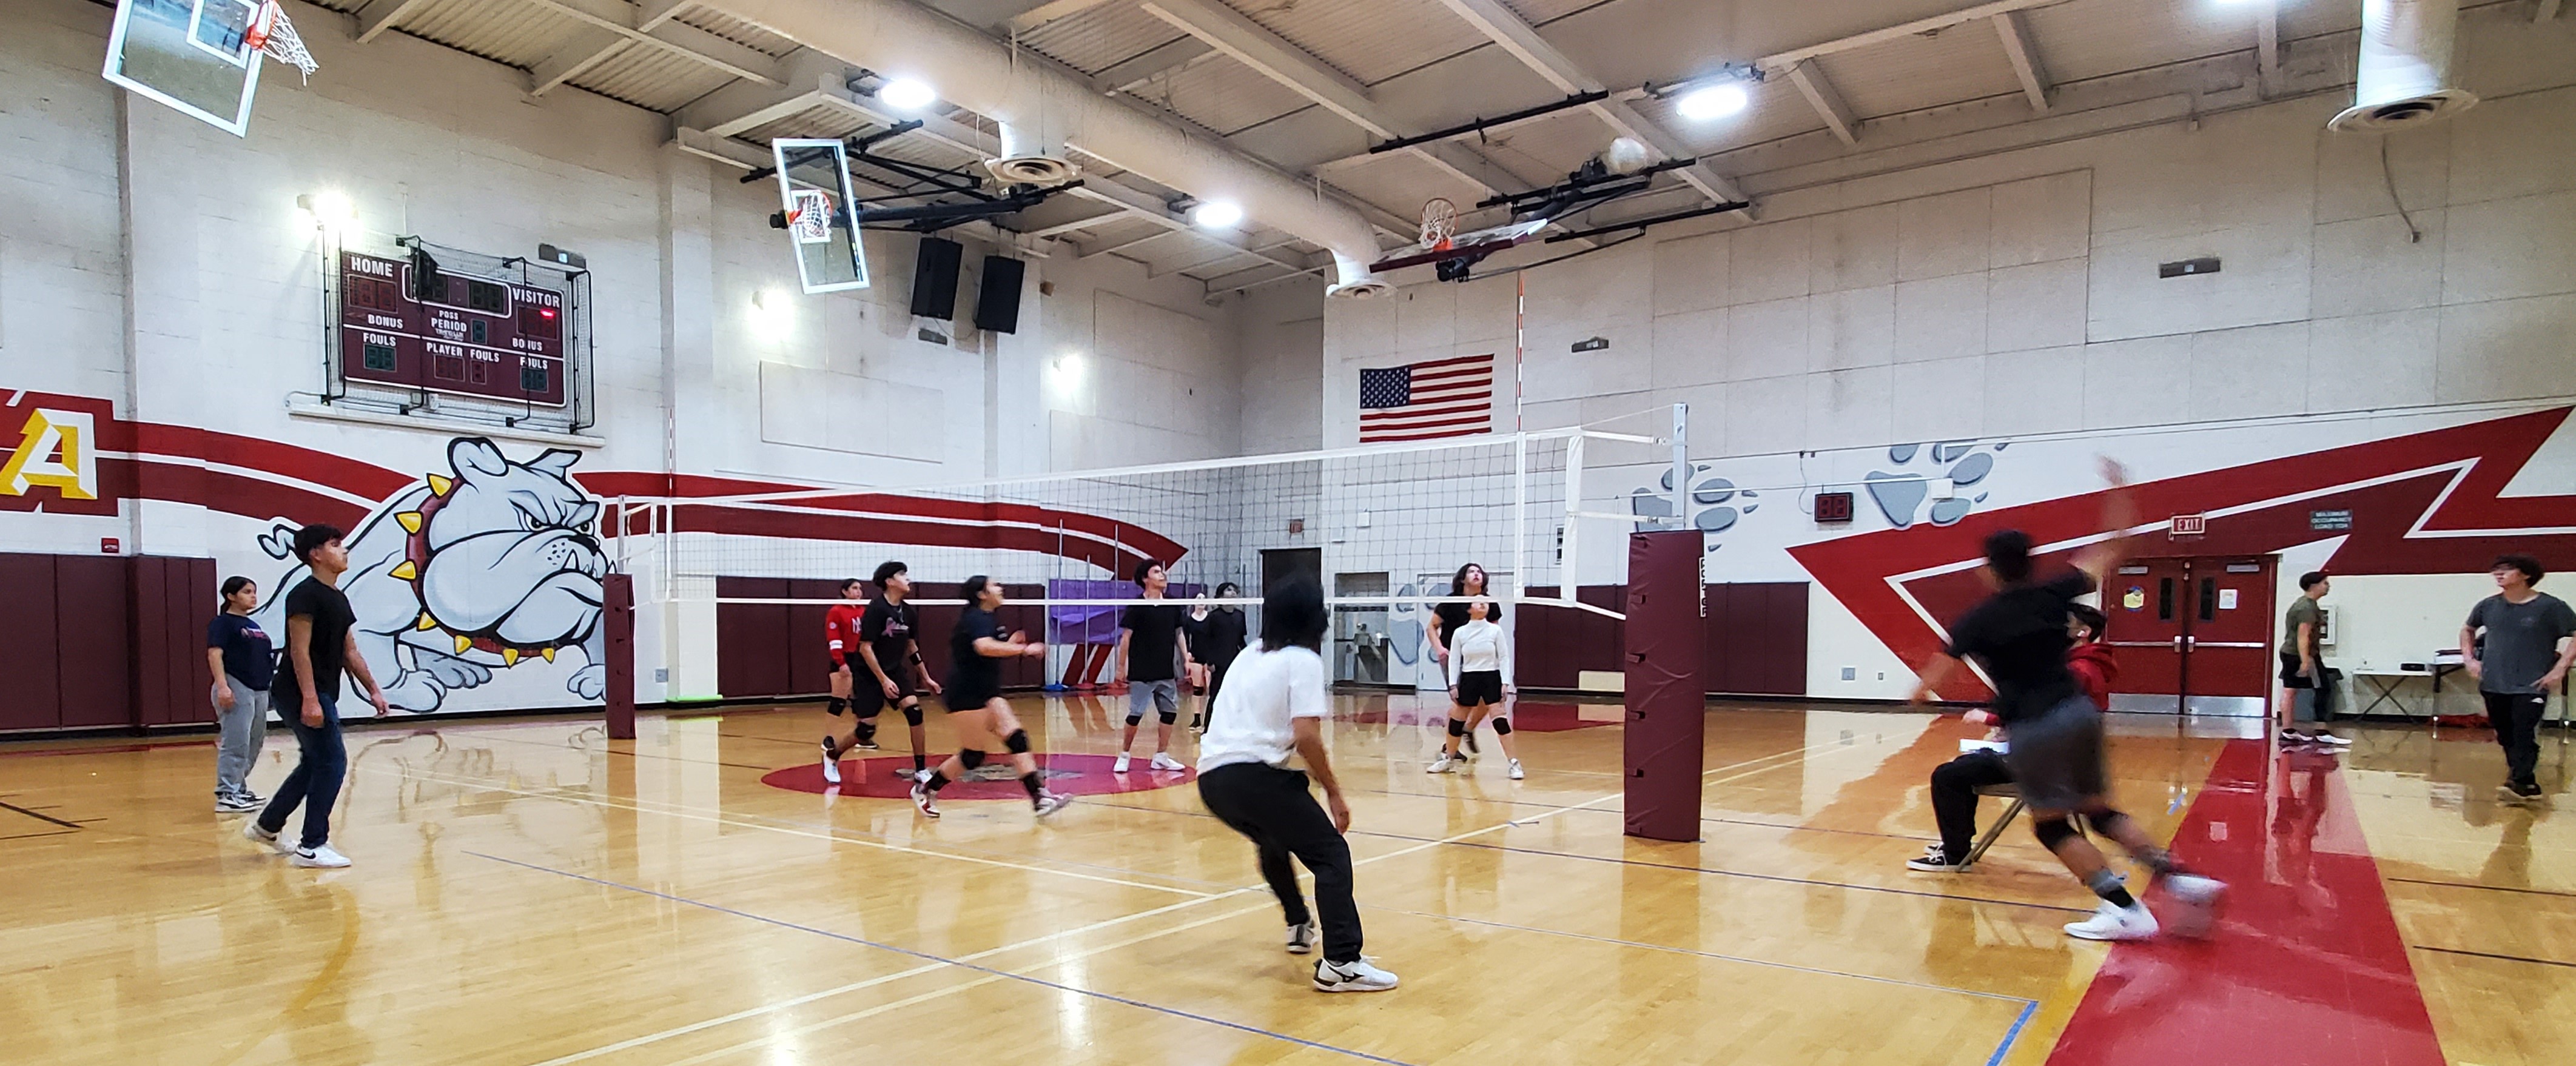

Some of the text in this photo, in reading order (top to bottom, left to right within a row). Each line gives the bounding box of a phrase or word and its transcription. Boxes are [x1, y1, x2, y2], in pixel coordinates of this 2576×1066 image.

[351, 256, 394, 277] HOME
[513, 287, 560, 308] VISITOR
[368, 314, 403, 329] BONUS
[439, 310, 459, 320] POSS
[431, 317, 467, 332] PERIOD
[363, 332, 396, 347] FOULS
[426, 342, 500, 363] PLAYER FOULS
[2177, 518, 2200, 531] EXIT
